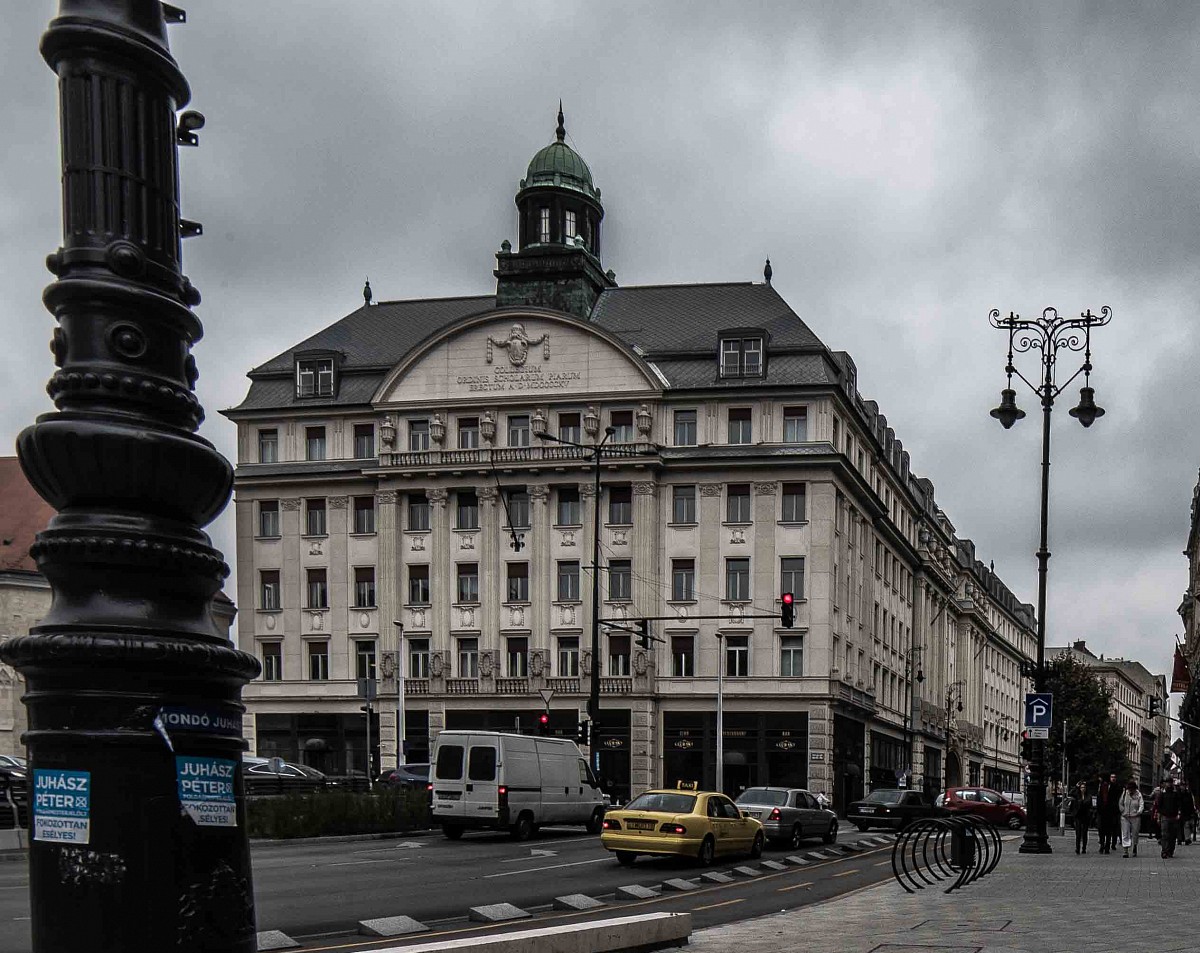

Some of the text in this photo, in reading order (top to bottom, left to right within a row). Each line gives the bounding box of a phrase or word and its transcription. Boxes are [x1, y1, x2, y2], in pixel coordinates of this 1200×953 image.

[1033, 705, 1046, 723] P
[180, 761, 233, 778] JUHÁSZ
[36, 773, 87, 791] JUHÁSZ
[181, 777, 225, 794] PÉTER
[36, 790, 74, 808] PÉTER
[36, 818, 87, 829] FOKOZOTTAN
[198, 813, 229, 824] SÉLYES!
